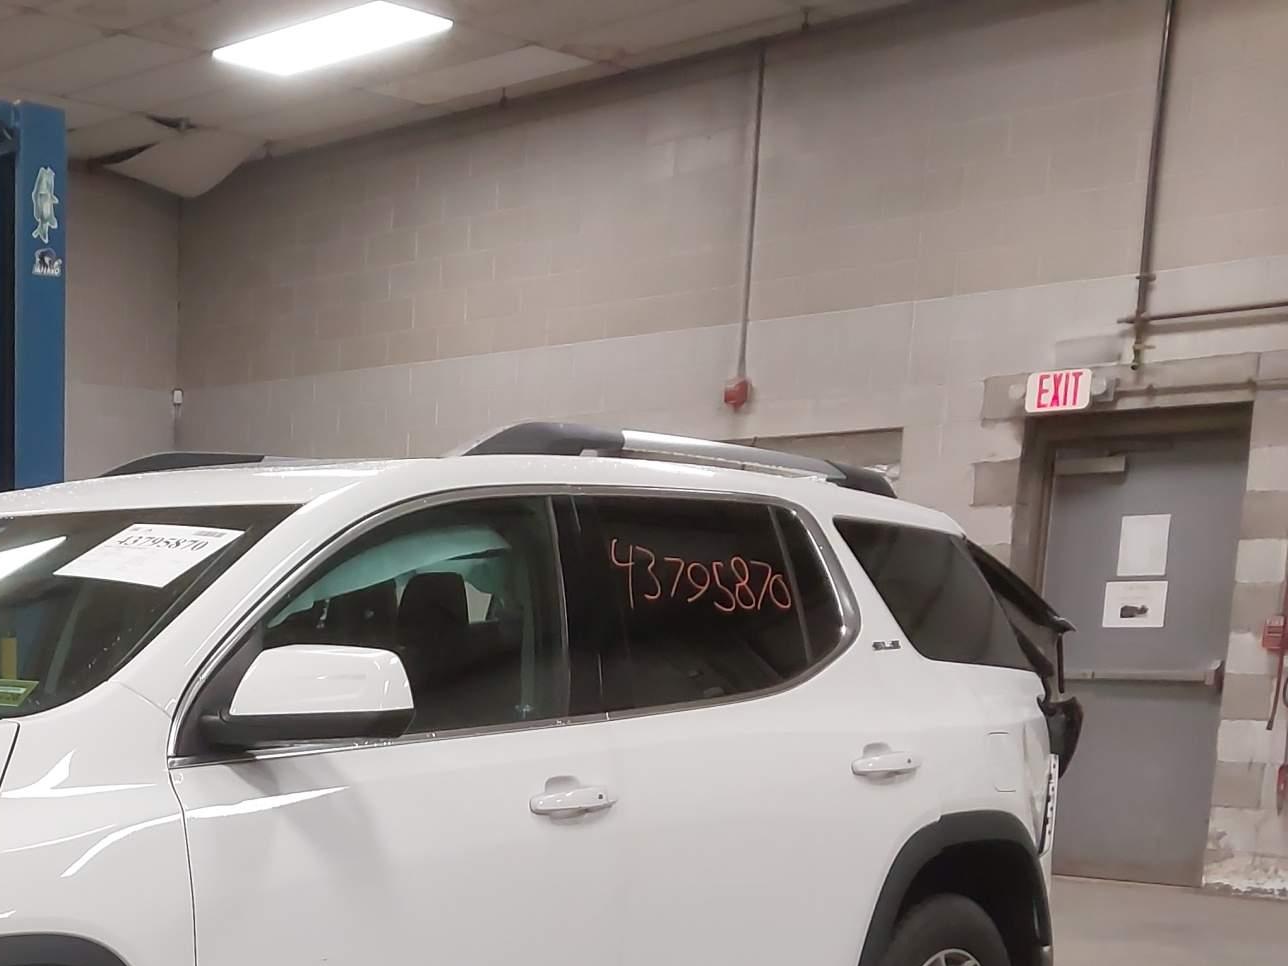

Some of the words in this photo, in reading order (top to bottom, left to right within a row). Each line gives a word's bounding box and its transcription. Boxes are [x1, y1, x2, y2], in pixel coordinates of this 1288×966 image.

[1037, 372, 1083, 409] EXIT
[116, 535, 209, 551] 43795870
[610, 538, 791, 612] 43795870
